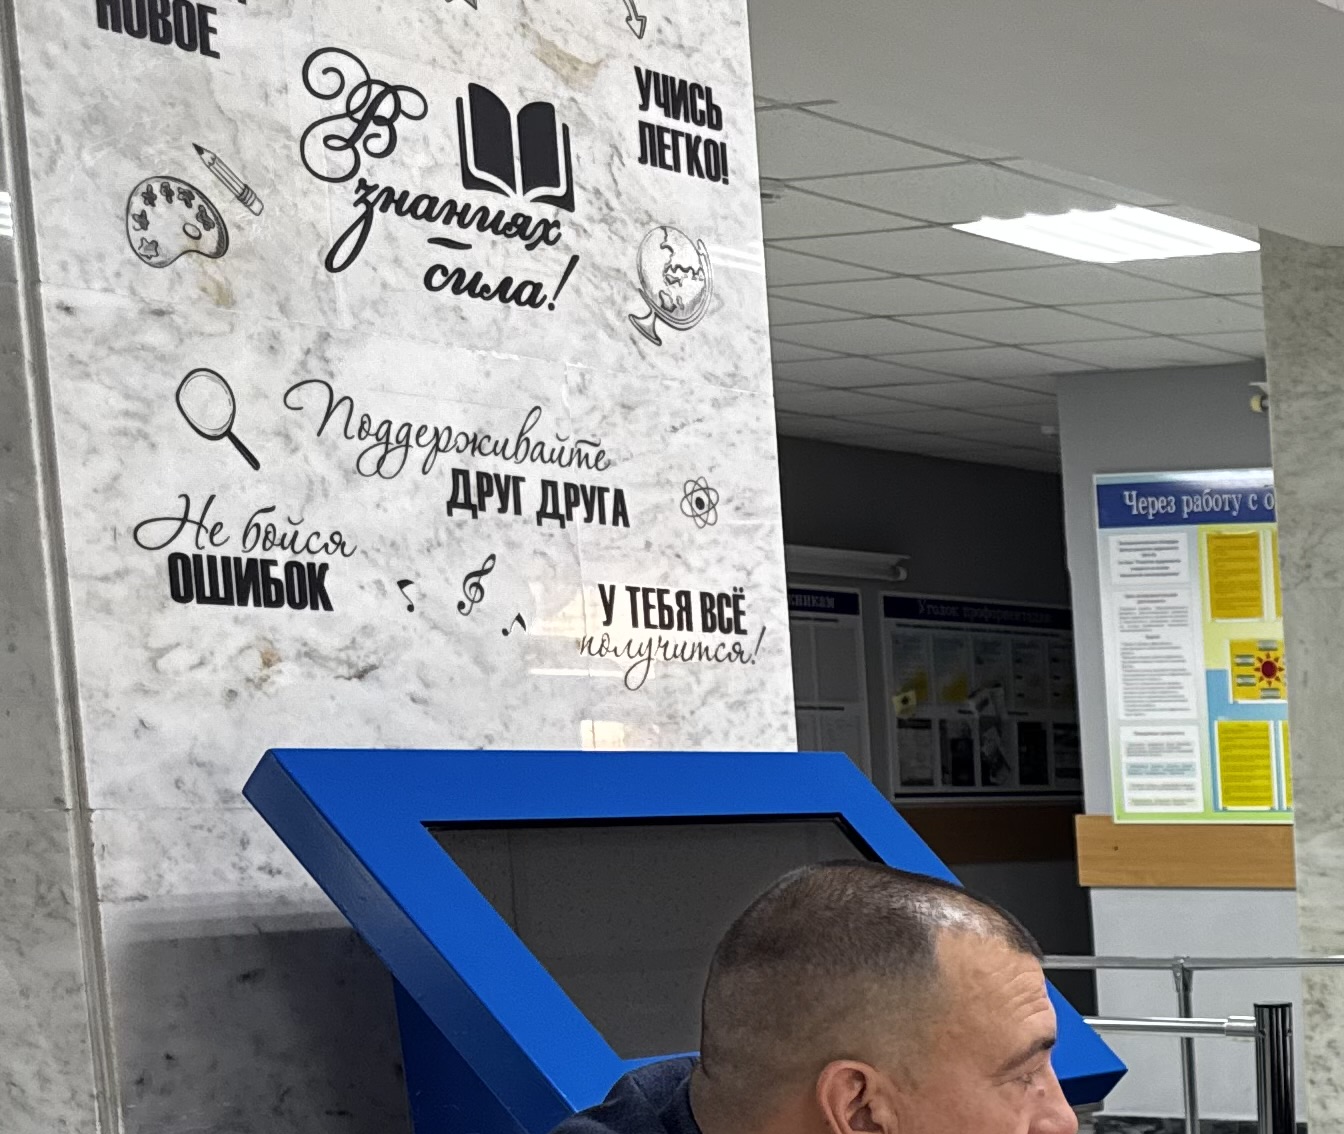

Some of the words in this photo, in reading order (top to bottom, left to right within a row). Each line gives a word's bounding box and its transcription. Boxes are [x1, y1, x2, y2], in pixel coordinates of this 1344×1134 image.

[301, 47, 428, 183] В
[634, 66, 723, 130] УЧИСЬ
[637, 120, 730, 186] ЛЕГКО!
[325, 177, 562, 273] знаниях
[424, 255, 579, 311] сила!
[283, 378, 612, 478] Поддерживайте
[133, 494, 230, 553] Не
[240, 505, 357, 558] бойся
[446, 468, 528, 519] ДРУГ
[535, 478, 631, 529] ДРУГА
[1123, 490, 1176, 520] Через
[1182, 488, 1242, 519] работу
[1249, 497, 1258, 511] с
[168, 552, 333, 612] ОШИБОК
[597, 584, 617, 627] У
[625, 589, 694, 634] ТЕБЯ
[700, 586, 749, 636] ВСЁ
[578, 627, 766, 691] получится!
